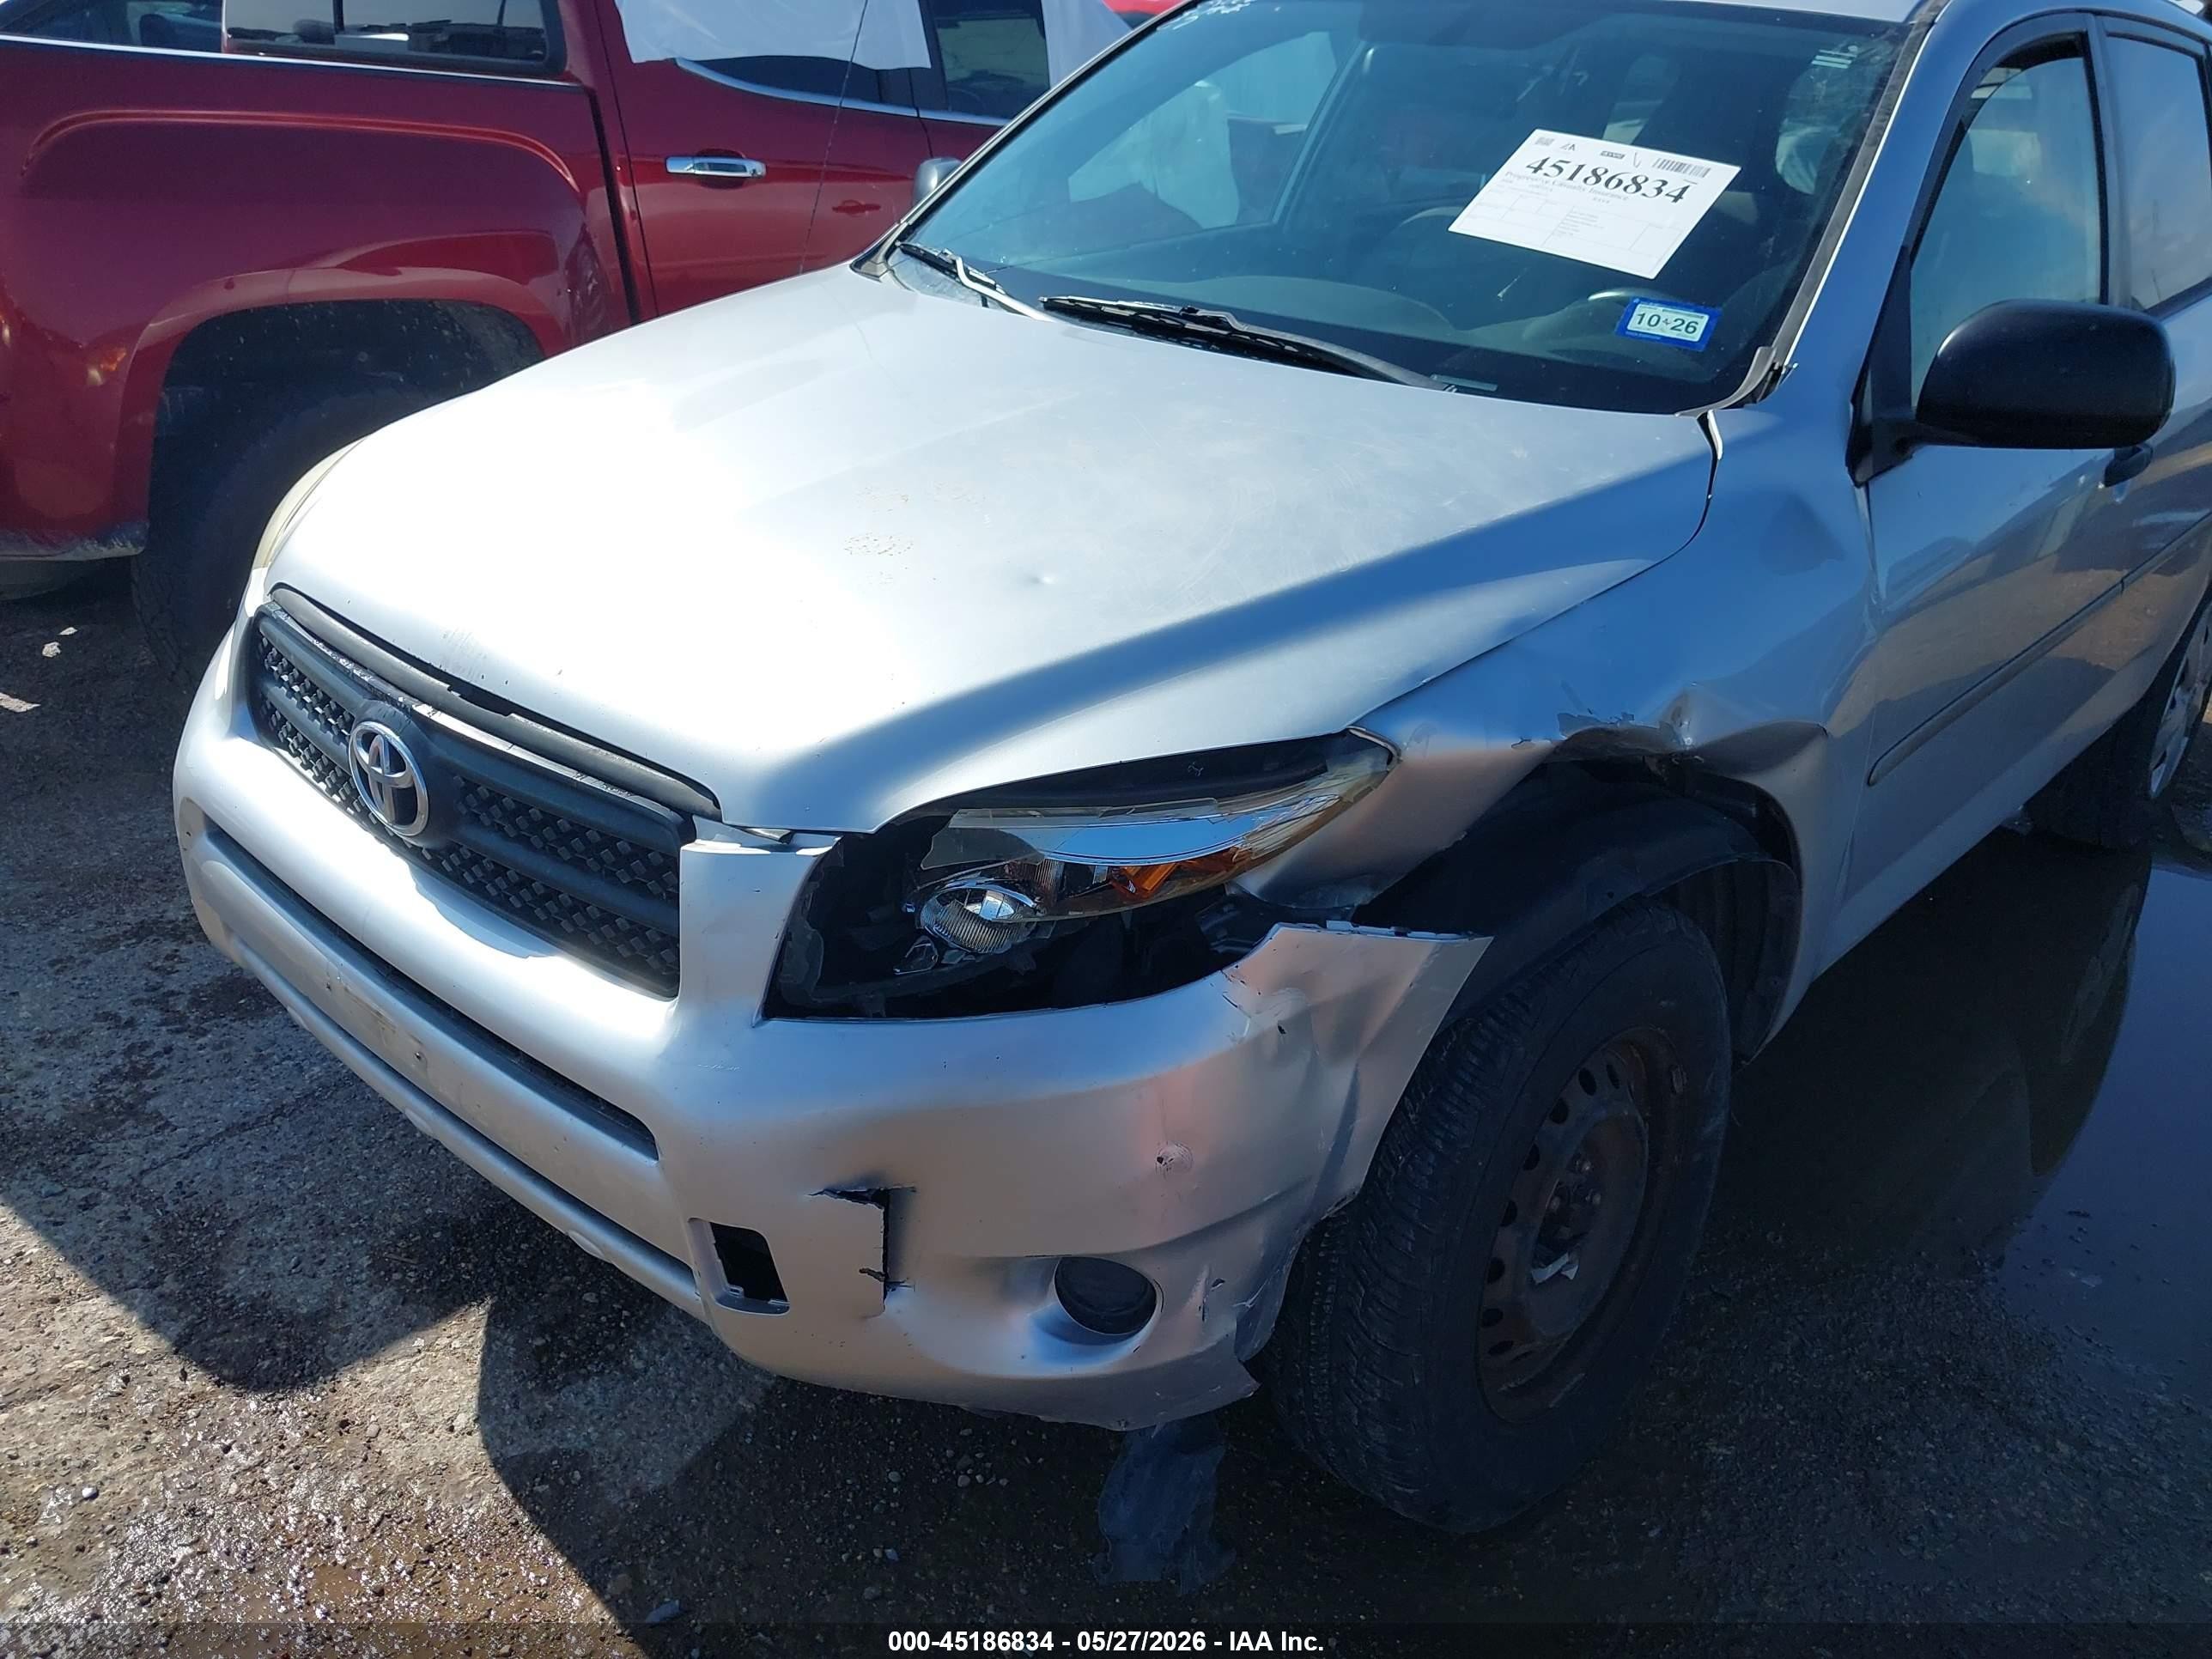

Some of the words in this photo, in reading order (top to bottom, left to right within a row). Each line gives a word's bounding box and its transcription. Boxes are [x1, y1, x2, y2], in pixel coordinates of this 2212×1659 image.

[1525, 156, 1689, 204] 45186834
[1637, 312, 1661, 328] 10
[1670, 318, 1698, 334] 26
